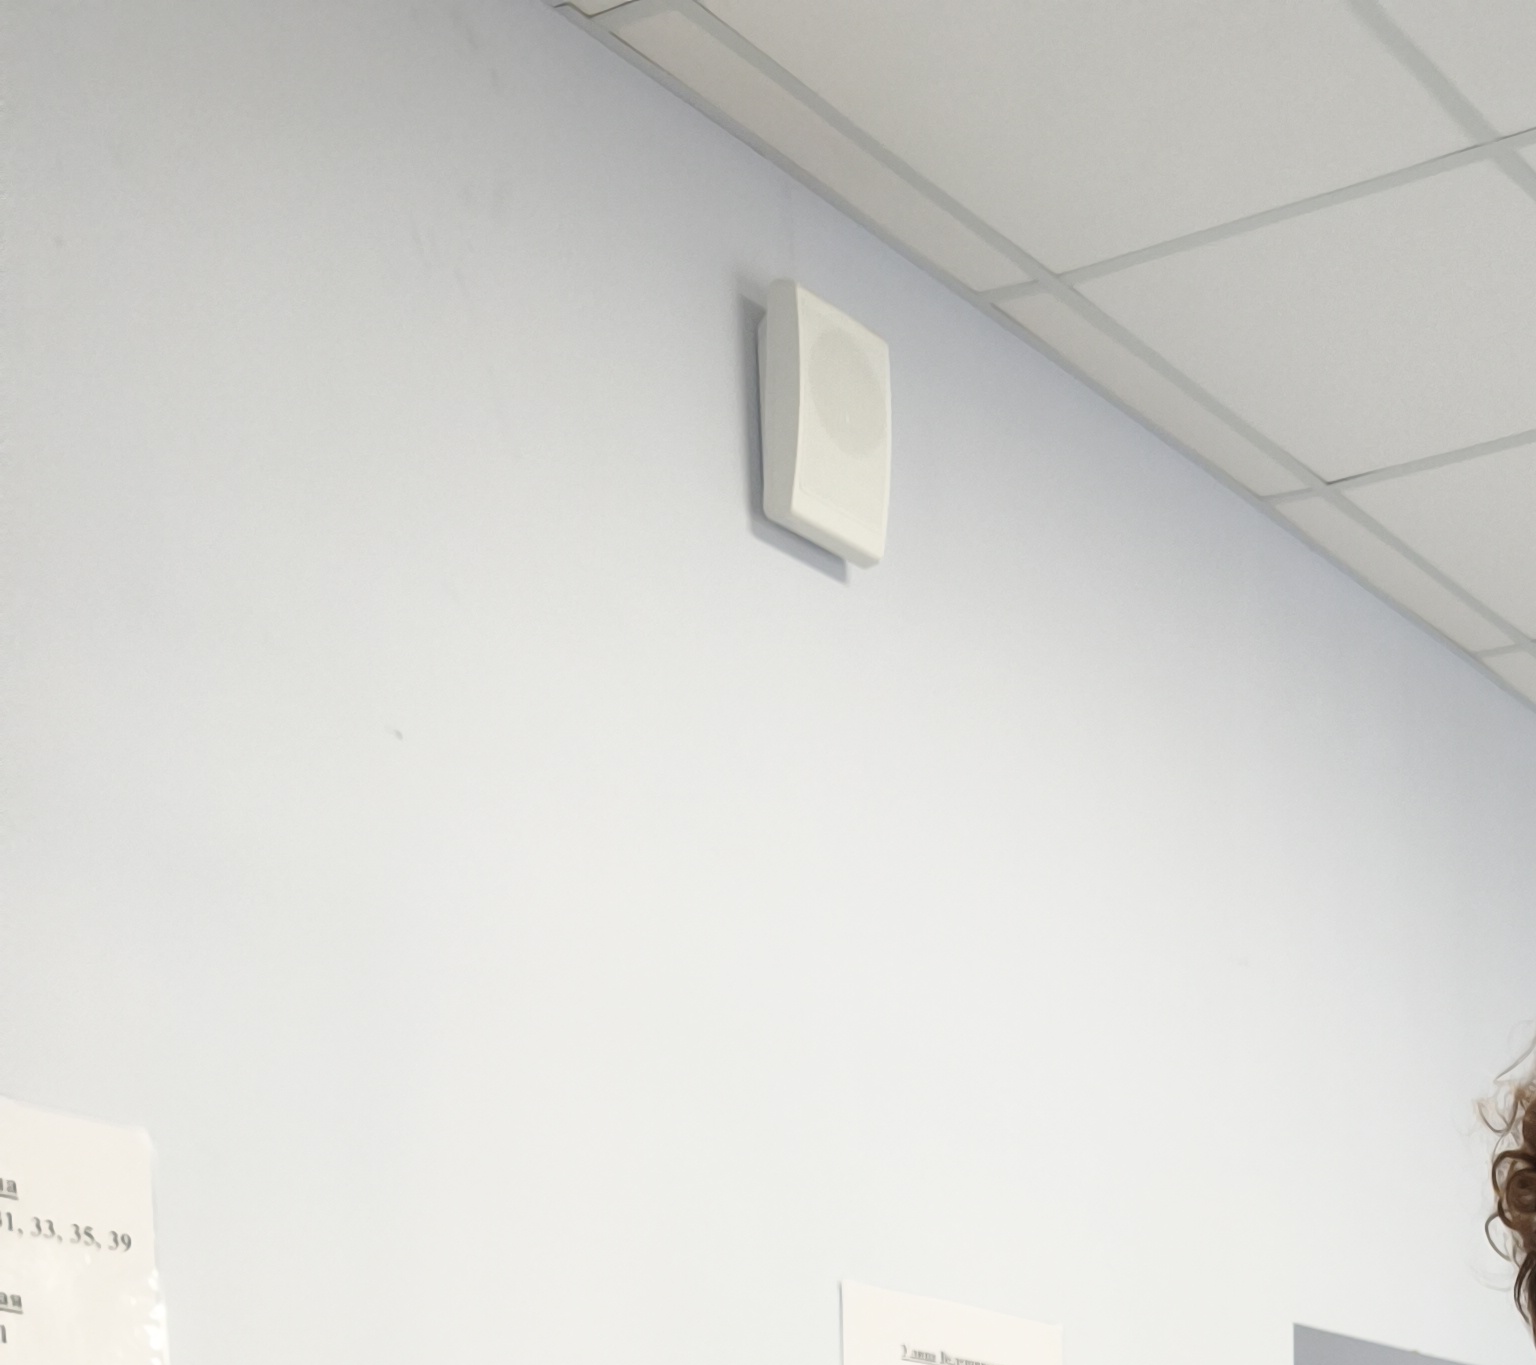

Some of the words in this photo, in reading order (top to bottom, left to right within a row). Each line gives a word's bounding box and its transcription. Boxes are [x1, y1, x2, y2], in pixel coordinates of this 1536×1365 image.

[30, 1216, 63, 1243] 33,
[69, 1223, 102, 1250] 35,
[107, 1230, 133, 1252] 39
